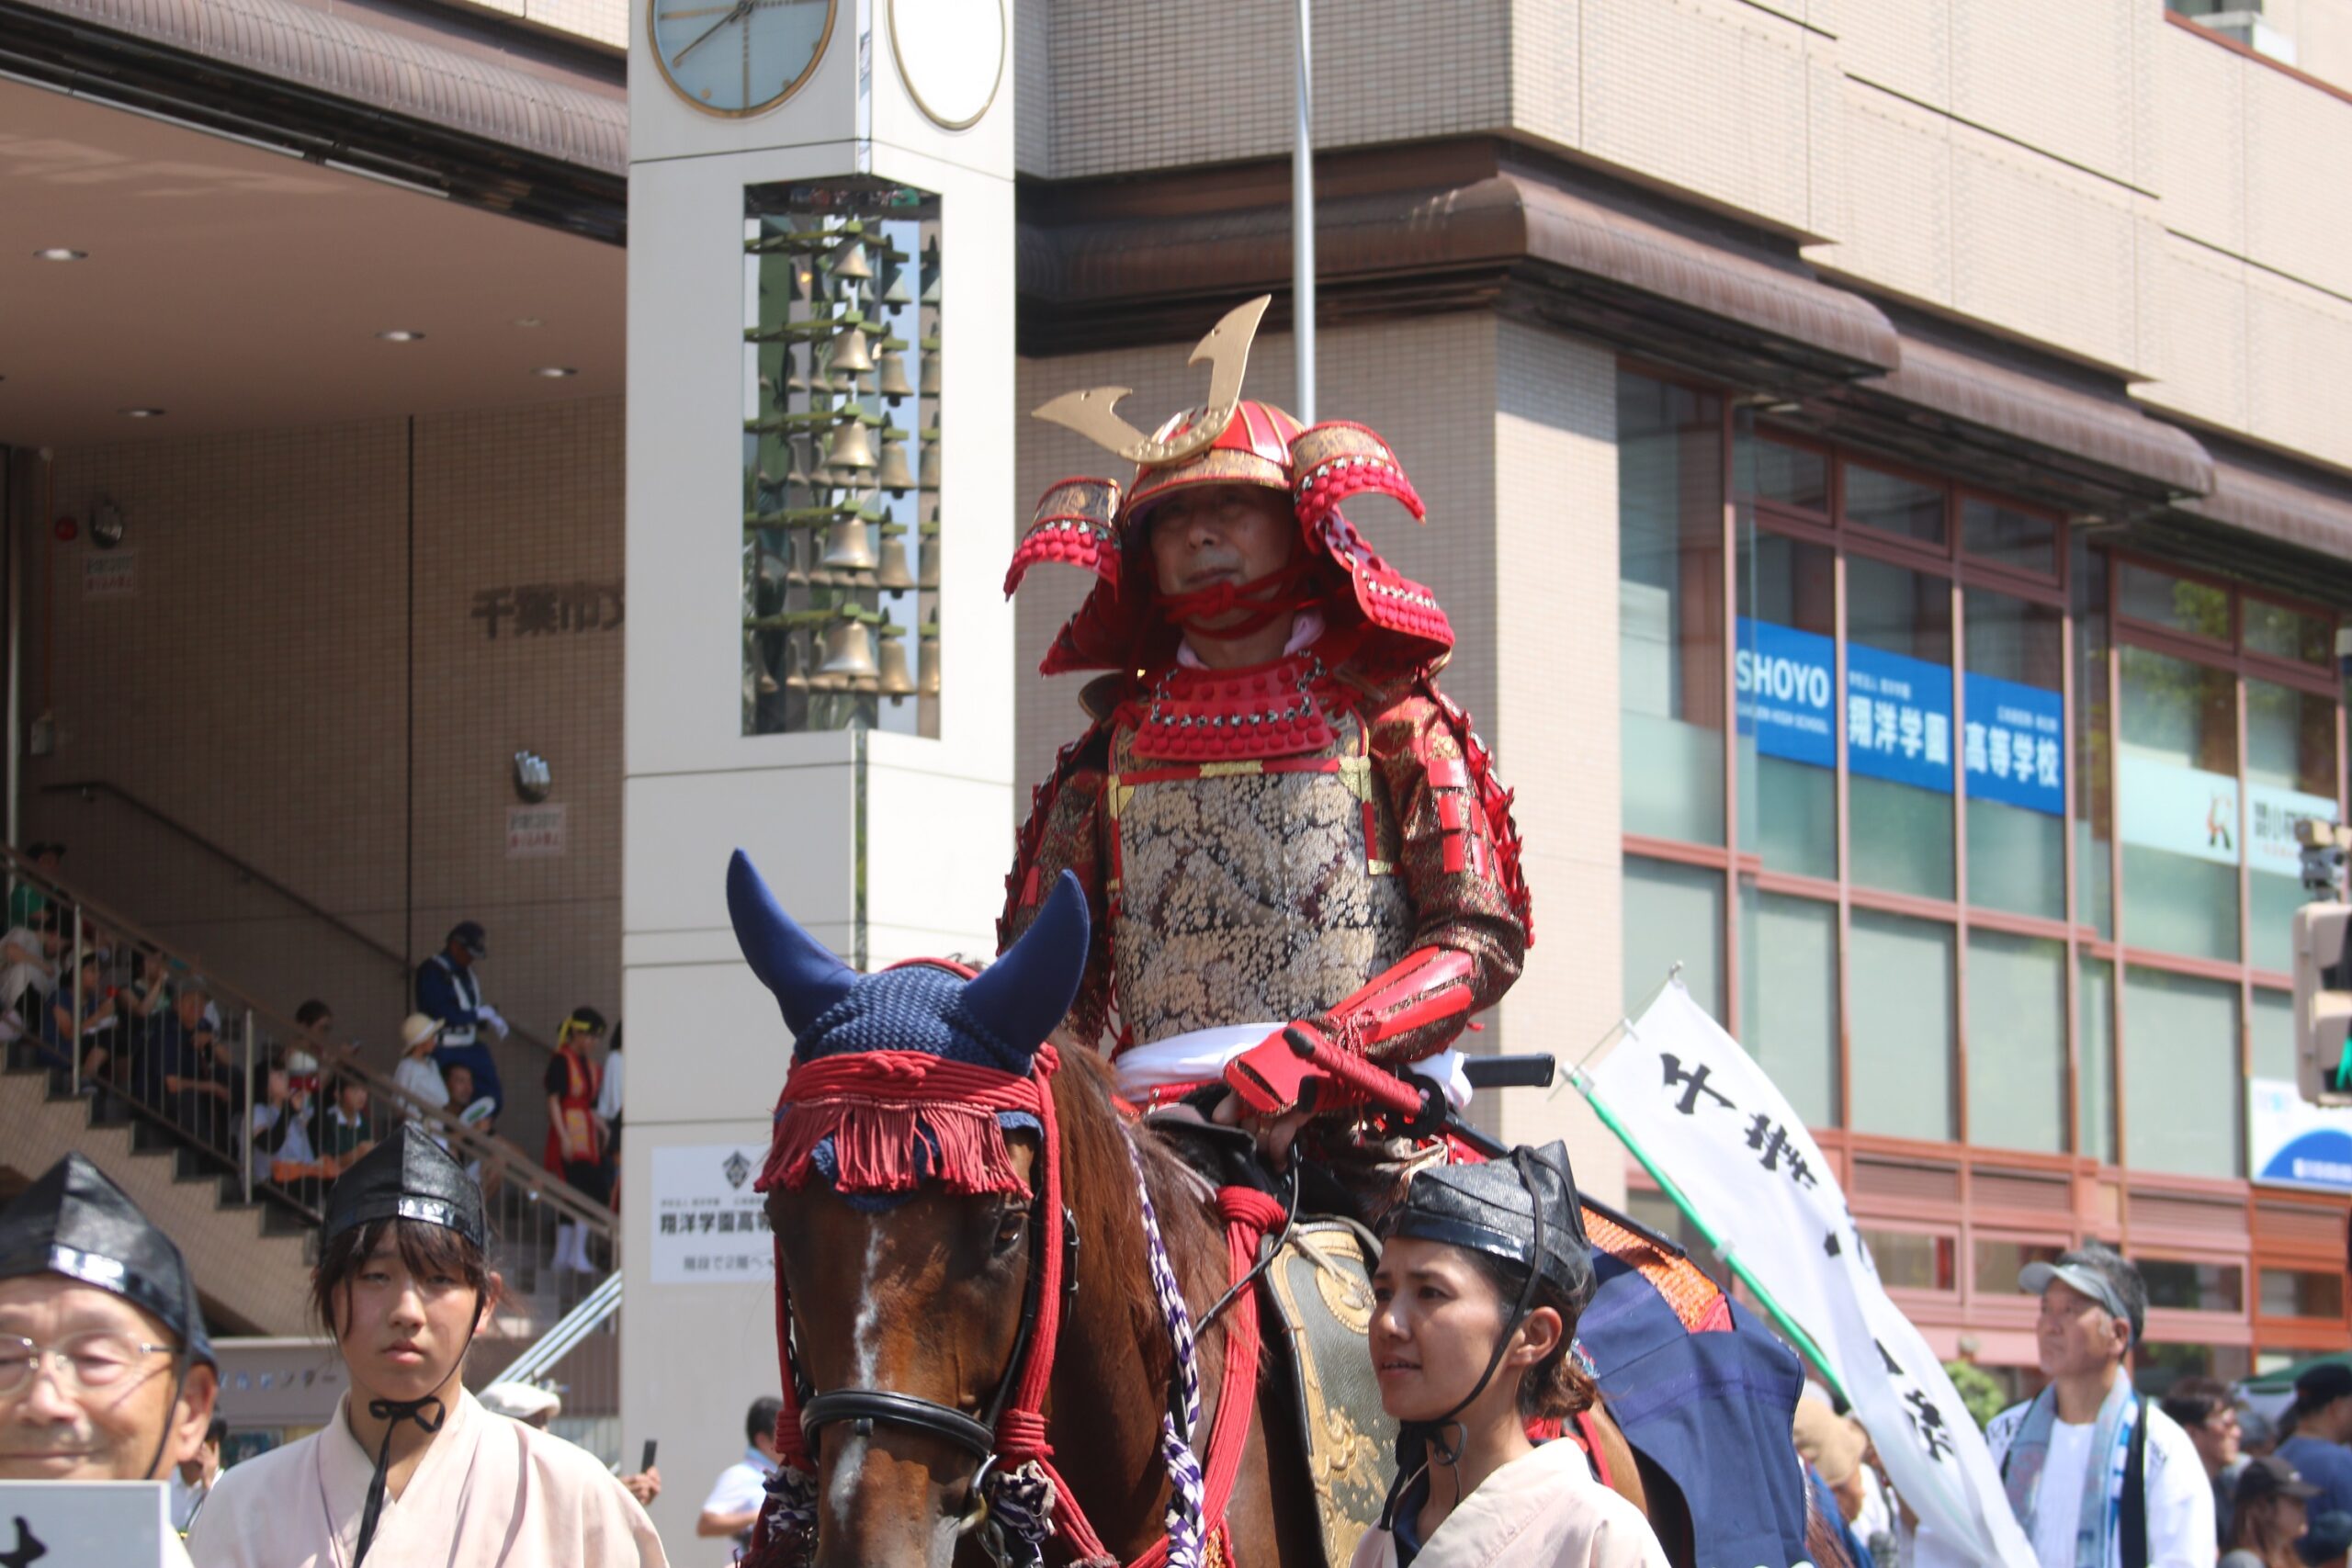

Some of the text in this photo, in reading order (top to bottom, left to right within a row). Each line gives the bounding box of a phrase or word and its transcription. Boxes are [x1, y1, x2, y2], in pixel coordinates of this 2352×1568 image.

[1736, 649, 1830, 708] SHOYO
[1964, 722, 2060, 788] 高等学校
